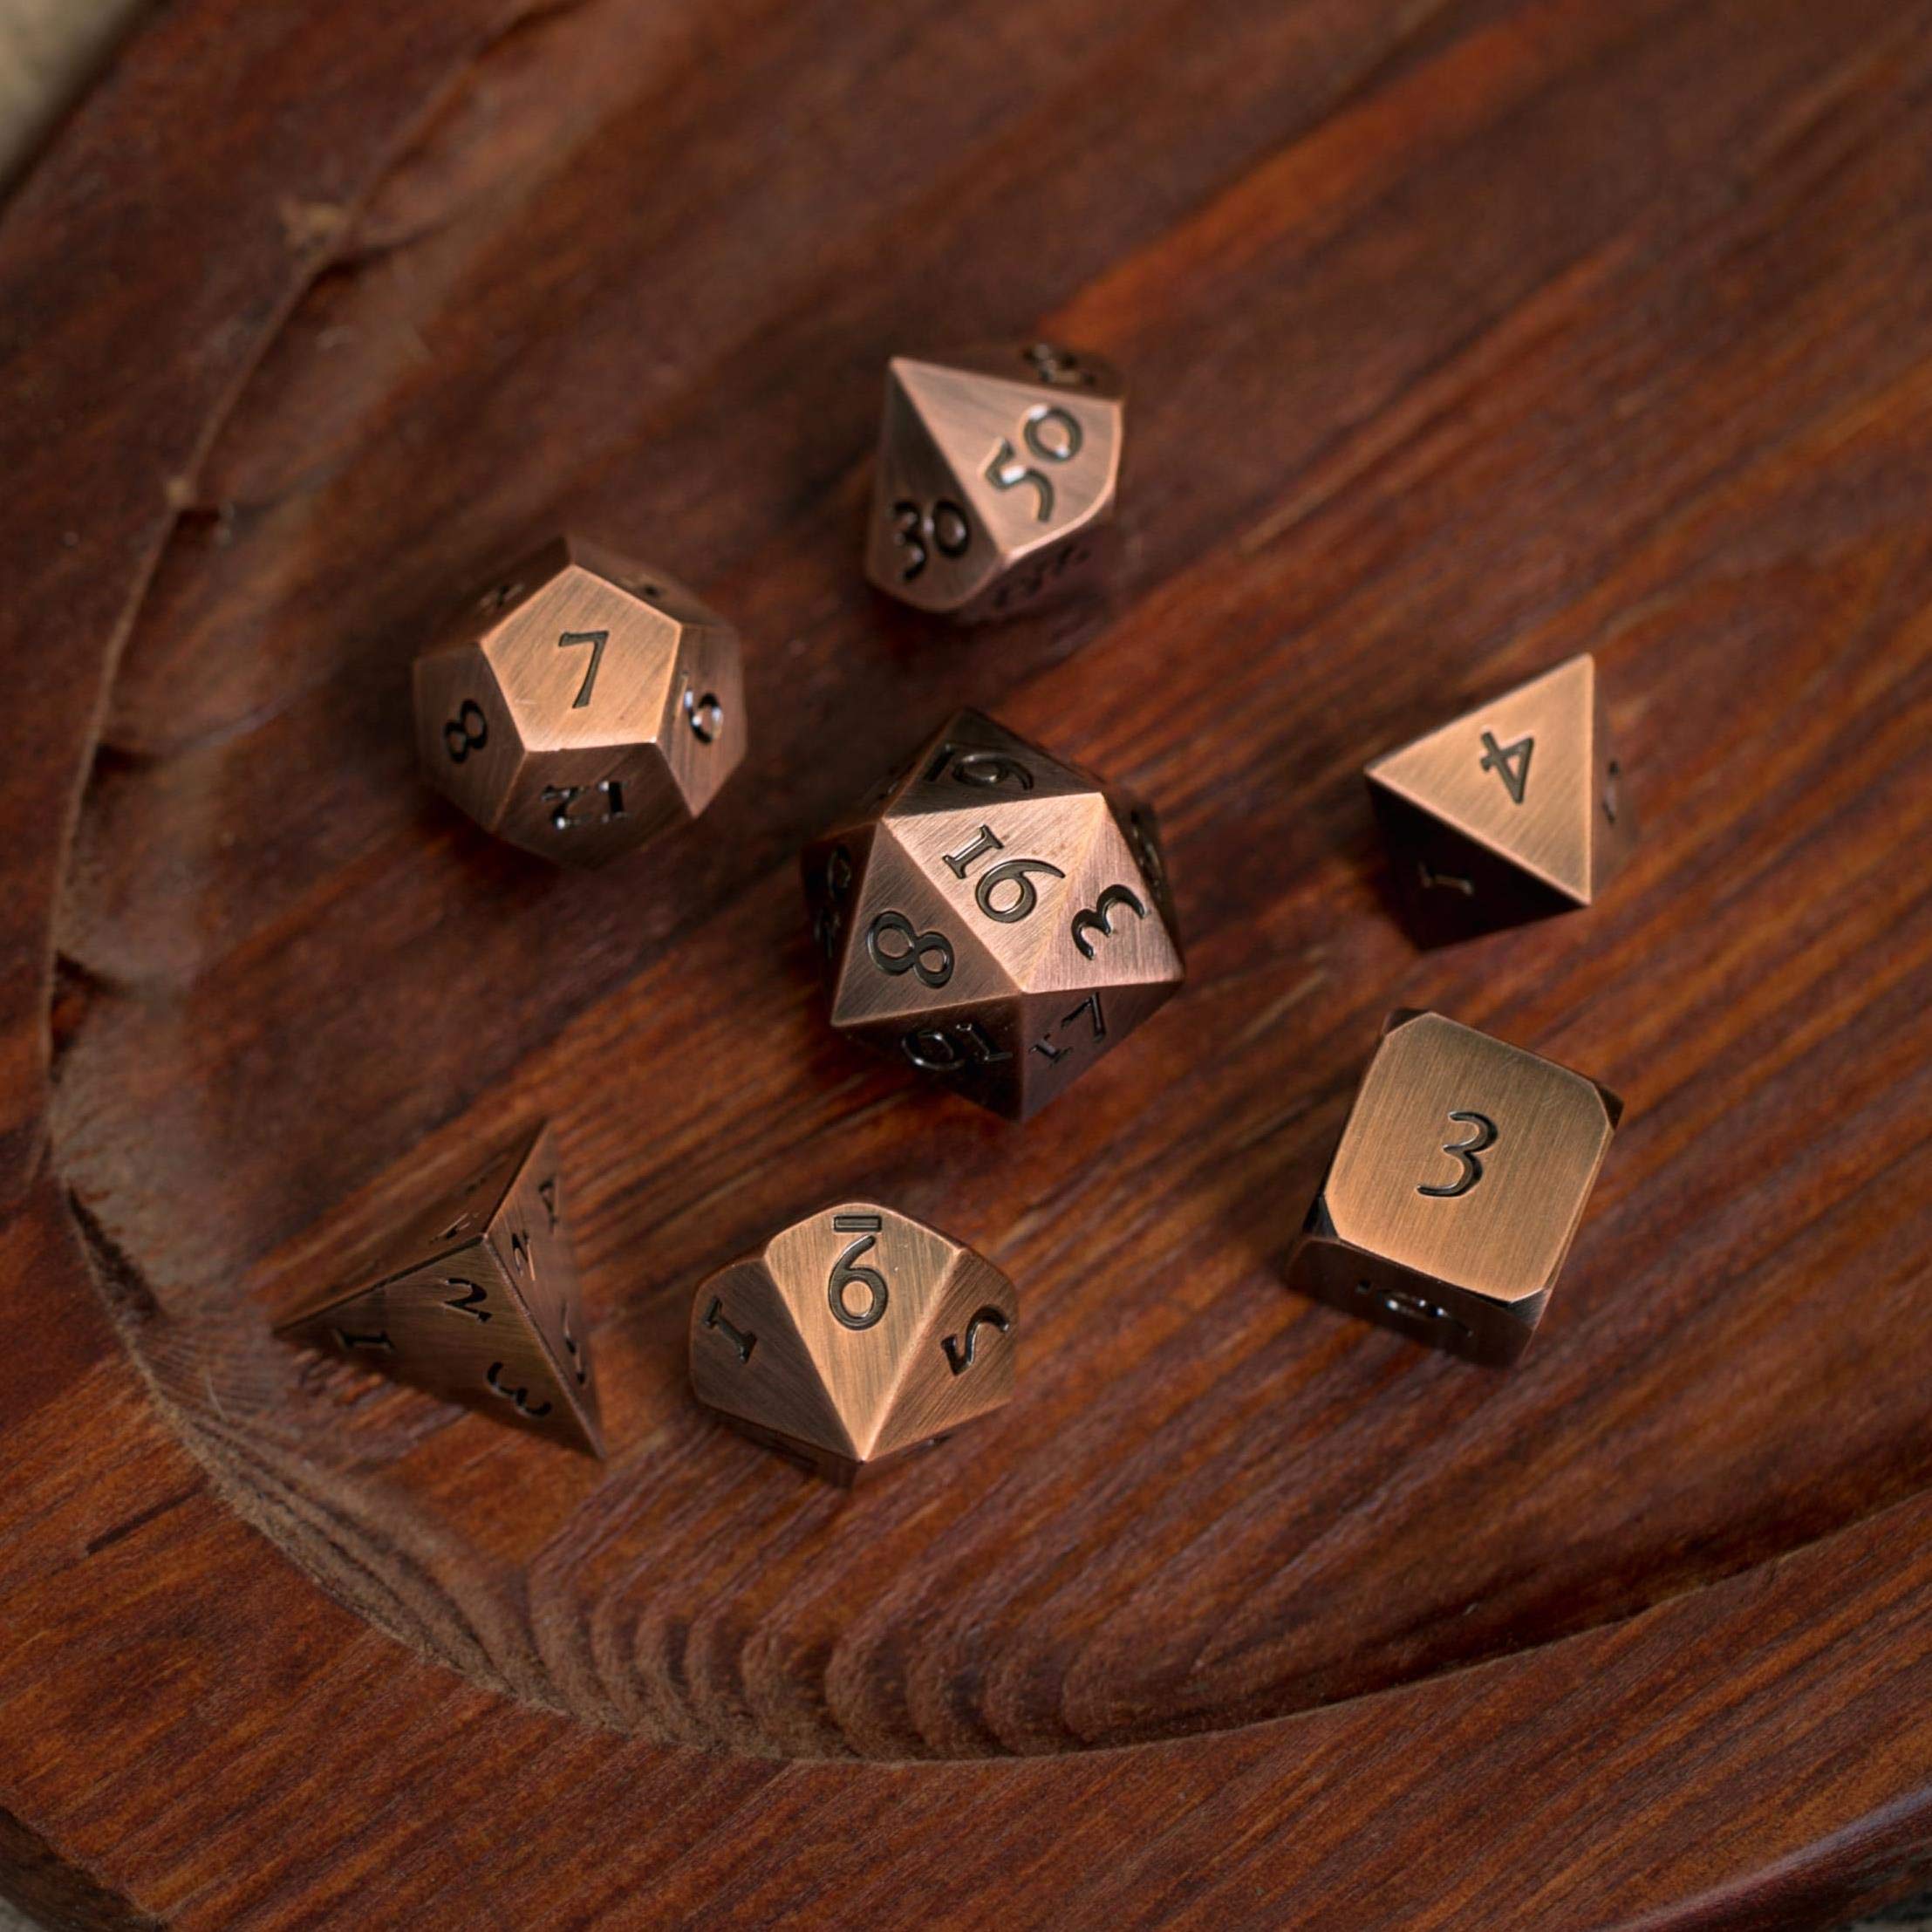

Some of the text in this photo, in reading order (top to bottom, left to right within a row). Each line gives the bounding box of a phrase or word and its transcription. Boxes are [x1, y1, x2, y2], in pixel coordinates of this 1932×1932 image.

[981, 405, 1083, 524] 50
[891, 500, 971, 582] 30
[558, 630, 610, 709] 7
[444, 700, 488, 763] 8
[1479, 731, 1535, 805] 4
[942, 823, 1067, 924] 16
[866, 910, 956, 989] 8
[1071, 884, 1150, 960] 3
[1416, 1110, 1500, 1198] 3
[440, 1277, 495, 1324] 2
[703, 1296, 758, 1364] 1
[331, 1326, 396, 1355] 1
[484, 1361, 553, 1417] 3
